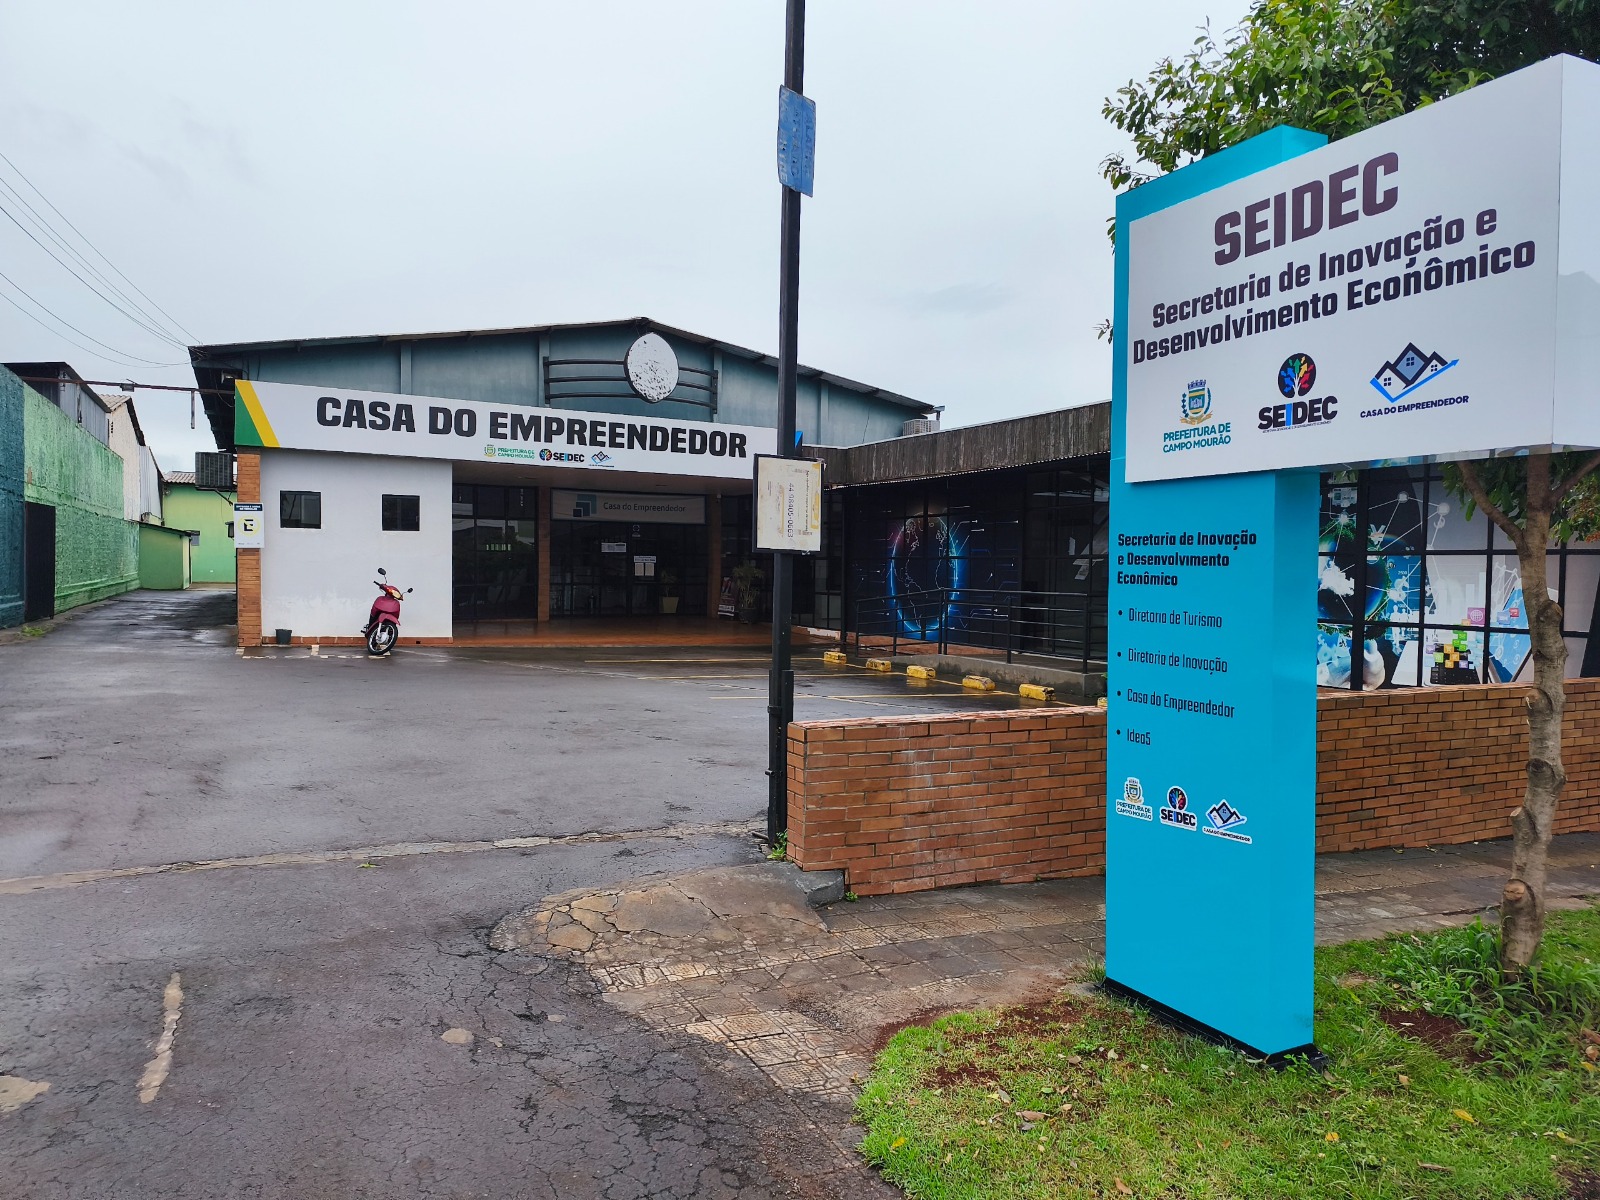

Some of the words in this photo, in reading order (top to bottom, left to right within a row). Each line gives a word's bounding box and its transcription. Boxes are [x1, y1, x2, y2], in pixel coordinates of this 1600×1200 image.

[1214, 151, 1399, 266] SEIDEC
[1152, 273, 1271, 328] Secretaria
[1279, 261, 1311, 292] de
[1319, 215, 1465, 282] Inovação
[1476, 208, 1497, 236] e
[1133, 291, 1338, 364] Desenvolvimento
[1348, 240, 1536, 311] Econômico
[1258, 396, 1338, 430] SEIDEC
[1360, 408, 1383, 418] CASA
[1384, 406, 1396, 415] DO
[1397, 395, 1469, 413] EMPREENDEDOR
[316, 396, 415, 433] CASA
[428, 406, 477, 438] DO
[490, 411, 747, 458] EMPREENDEDOR
[1163, 425, 1217, 442] PREFEITURA
[1218, 422, 1231, 433] DE
[497, 447, 527, 455] PREFEITURA
[1163, 441, 1192, 453] CAMPO
[1193, 434, 1231, 448] MOURÃO
[553, 452, 585, 462] SEIDEC
[603, 502, 621, 511] Casa
[622, 502, 632, 511] do
[633, 503, 686, 514] Empreendedor
[1118, 532, 1176, 546] Secretaria
[1179, 531, 1194, 546] de
[1197, 530, 1257, 550] Inovação
[1117, 556, 1124, 566] e
[1127, 552, 1229, 567] Desenvolvimento
[1117, 571, 1178, 586] Econômico
[1128, 608, 1167, 623] Diretoria
[1169, 610, 1181, 625] de
[1183, 611, 1222, 628] Turismo
[1128, 648, 1166, 665] Diretoria
[1168, 651, 1180, 667] de
[1182, 654, 1228, 675] Inovação
[1127, 688, 1148, 704] Casa
[1150, 691, 1161, 706] do
[1164, 693, 1235, 718] Empreendedor
[1117, 801, 1144, 813] PREFEITURA
[1117, 807, 1132, 815] CAMPO
[1160, 808, 1196, 826] SEIDEC
